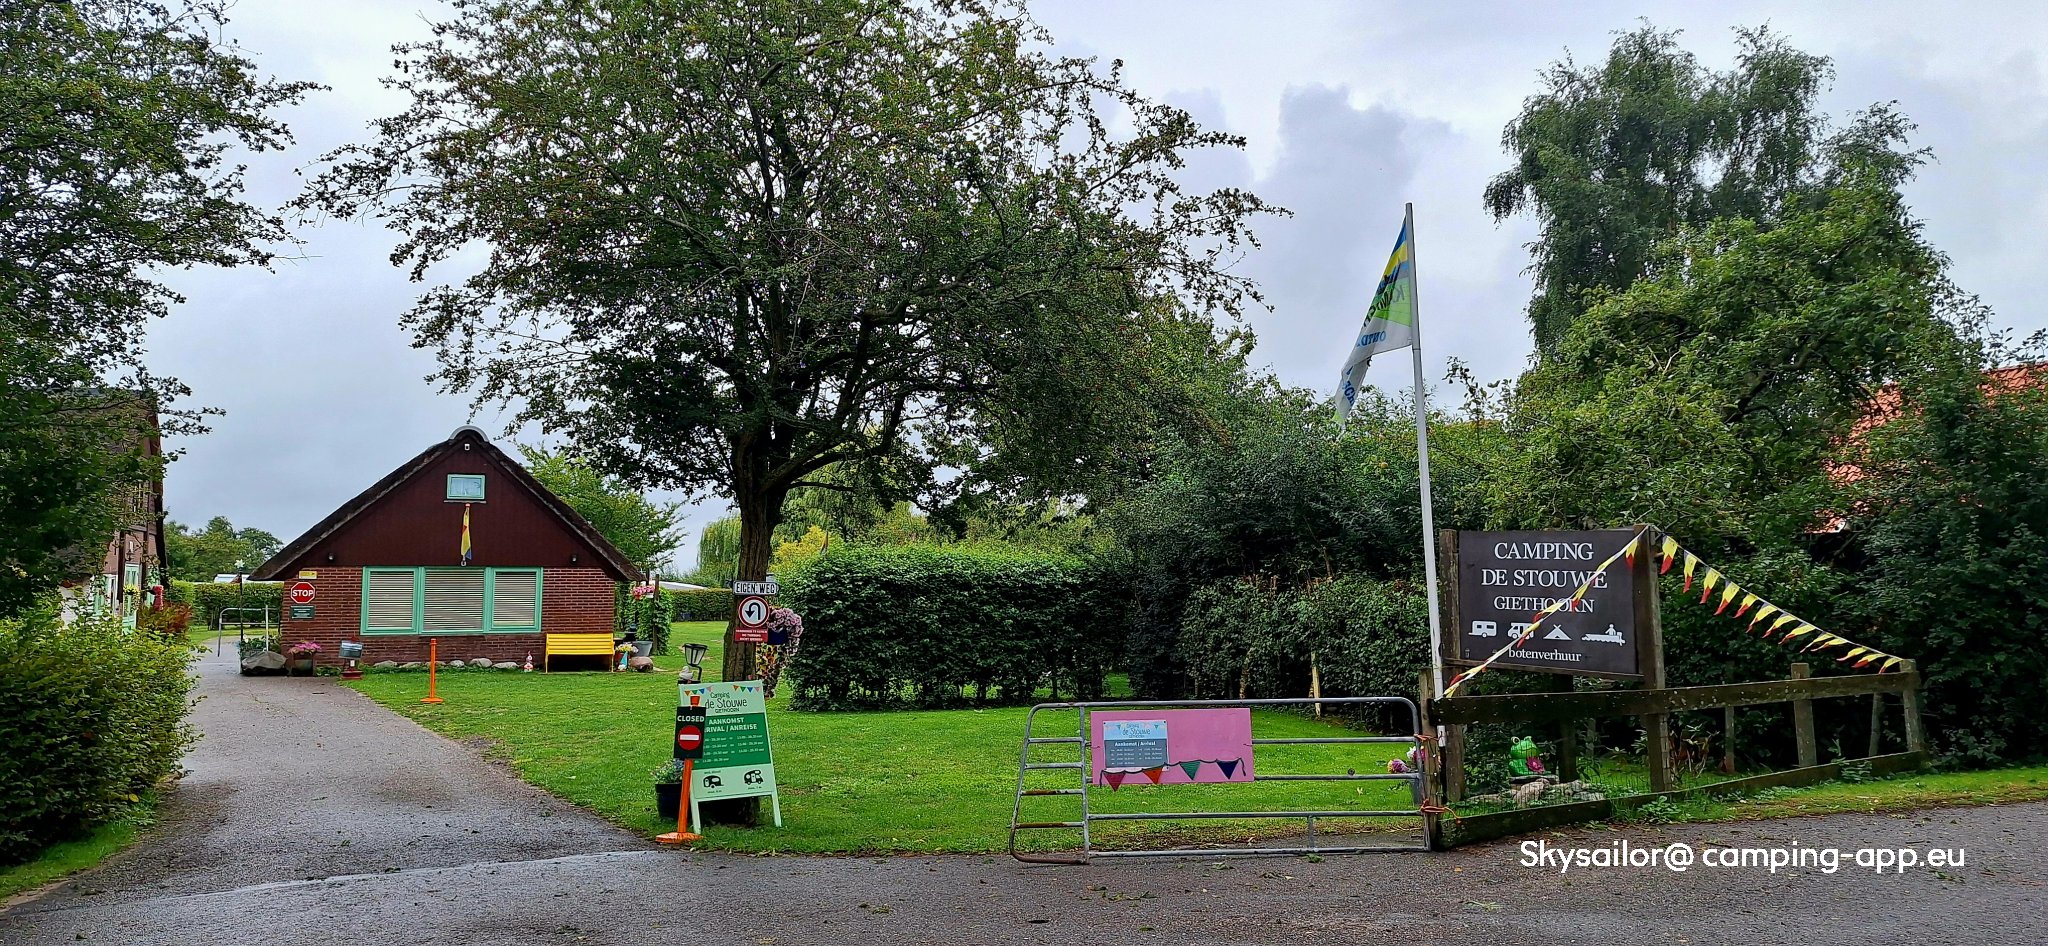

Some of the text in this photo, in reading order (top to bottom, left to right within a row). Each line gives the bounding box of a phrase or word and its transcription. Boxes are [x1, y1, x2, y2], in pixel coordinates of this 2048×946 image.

[1494, 542, 1595, 560] CAMPING
[1481, 568, 1608, 589] DE STOUWE
[759, 583, 775, 594] WEG
[1508, 645, 1582, 662] botenverhuur
[710, 691, 730, 699] Camping
[705, 698, 748, 709] de Stouwe
[677, 715, 705, 723] CLOSED
[709, 717, 744, 725] AANKOMST
[730, 723, 758, 731] ANREISE
